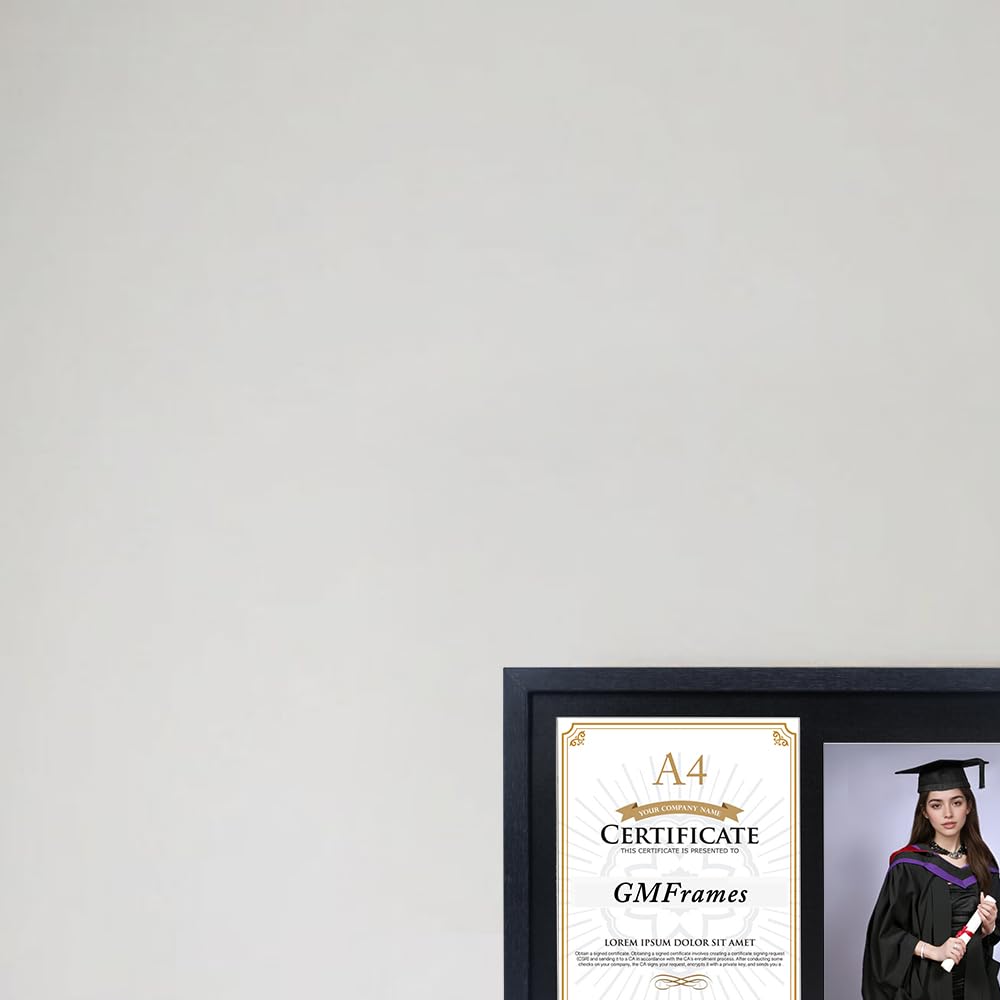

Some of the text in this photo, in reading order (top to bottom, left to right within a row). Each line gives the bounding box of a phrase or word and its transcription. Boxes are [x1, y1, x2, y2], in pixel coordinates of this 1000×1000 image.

[652, 752, 708, 785] A4
[638, 808, 660, 816] YOUR
[700, 806, 721, 816] NAME
[614, 882, 748, 903] GMFrames
[604, 938, 755, 946] LOREM IPSUM DOLOR SIT AMET
